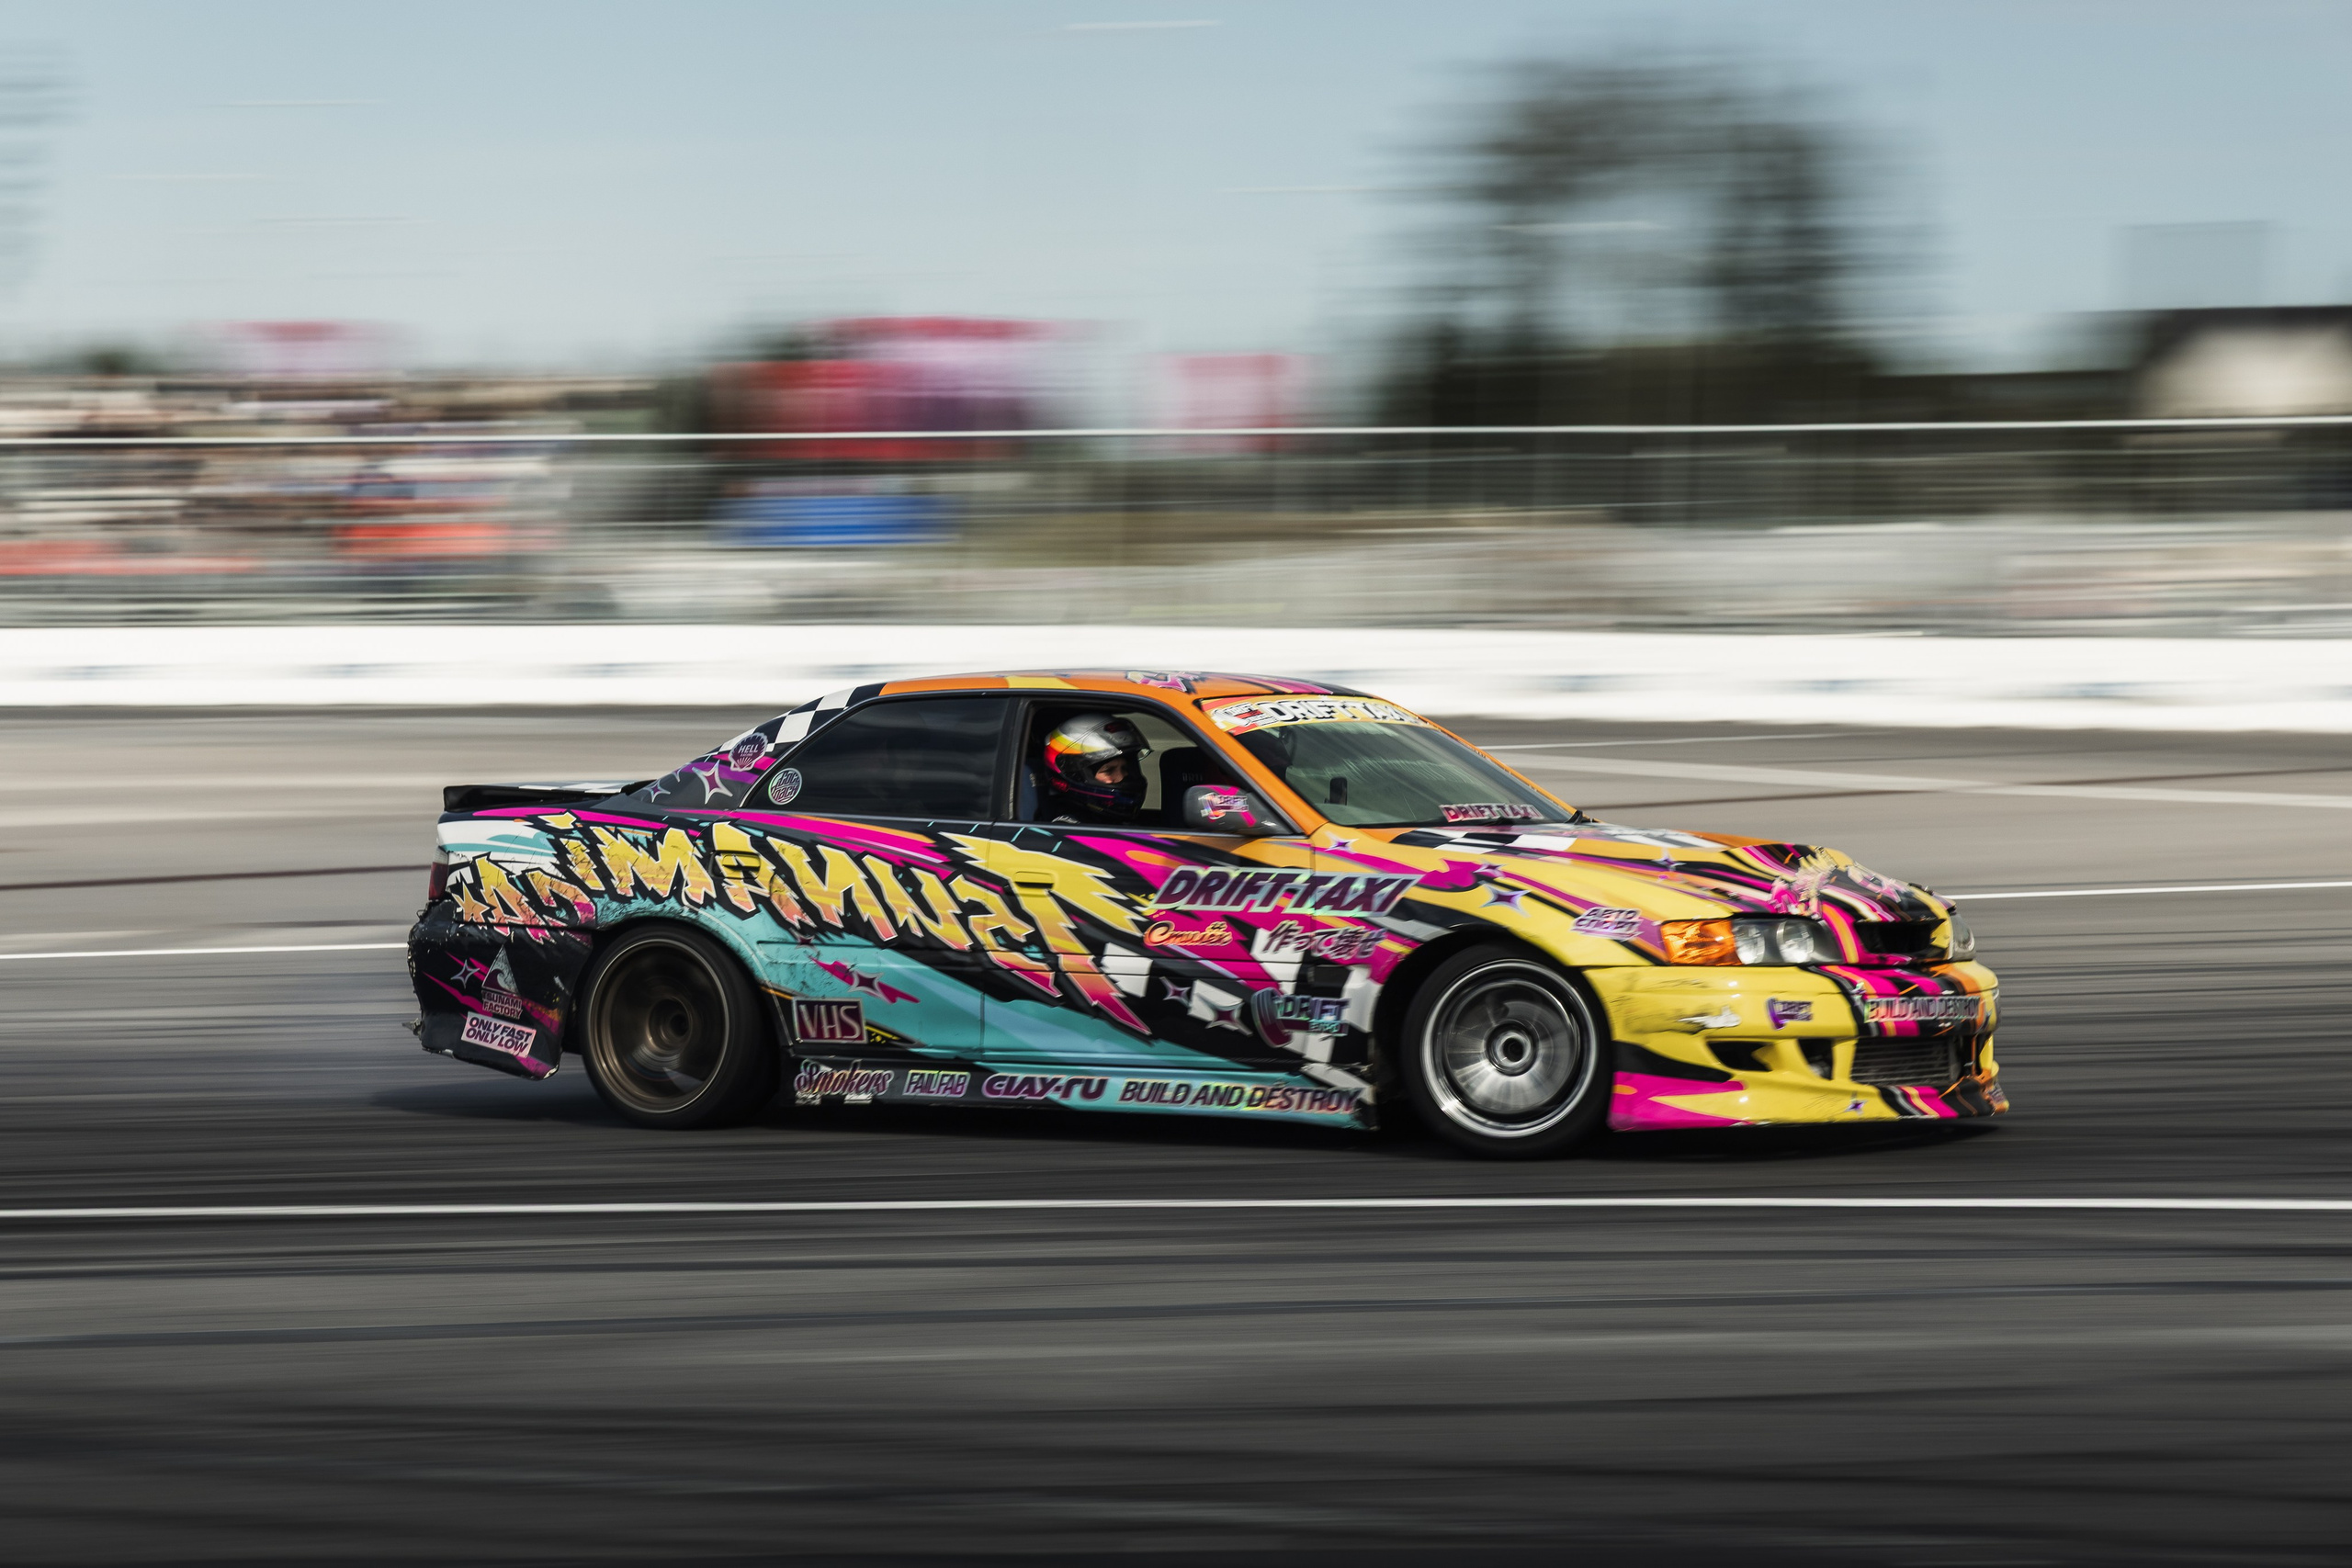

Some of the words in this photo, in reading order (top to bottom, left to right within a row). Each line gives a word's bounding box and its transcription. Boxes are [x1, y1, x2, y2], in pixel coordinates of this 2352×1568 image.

[1256, 700, 1359, 724] DRIFT
[738, 744, 759, 753] HELL
[1441, 804, 1499, 821] DRIFT
[1154, 869, 1304, 909] DRIFT
[1290, 874, 1419, 914] TAXI
[482, 992, 523, 1009] TSUNAMI
[483, 1001, 523, 1019] FACTORY
[1276, 995, 1351, 1021] DRIFT
[469, 1017, 502, 1033] ONLY
[500, 1024, 533, 1043] FAST
[798, 1004, 862, 1039] VHS
[465, 1028, 499, 1044] ONLY
[497, 1035, 529, 1054] LOW
[796, 1059, 893, 1095] Smokers
[1119, 1081, 1193, 1103] BUILD
[1188, 1083, 1246, 1108] AND
[1245, 1085, 1362, 1112] DESTROY
